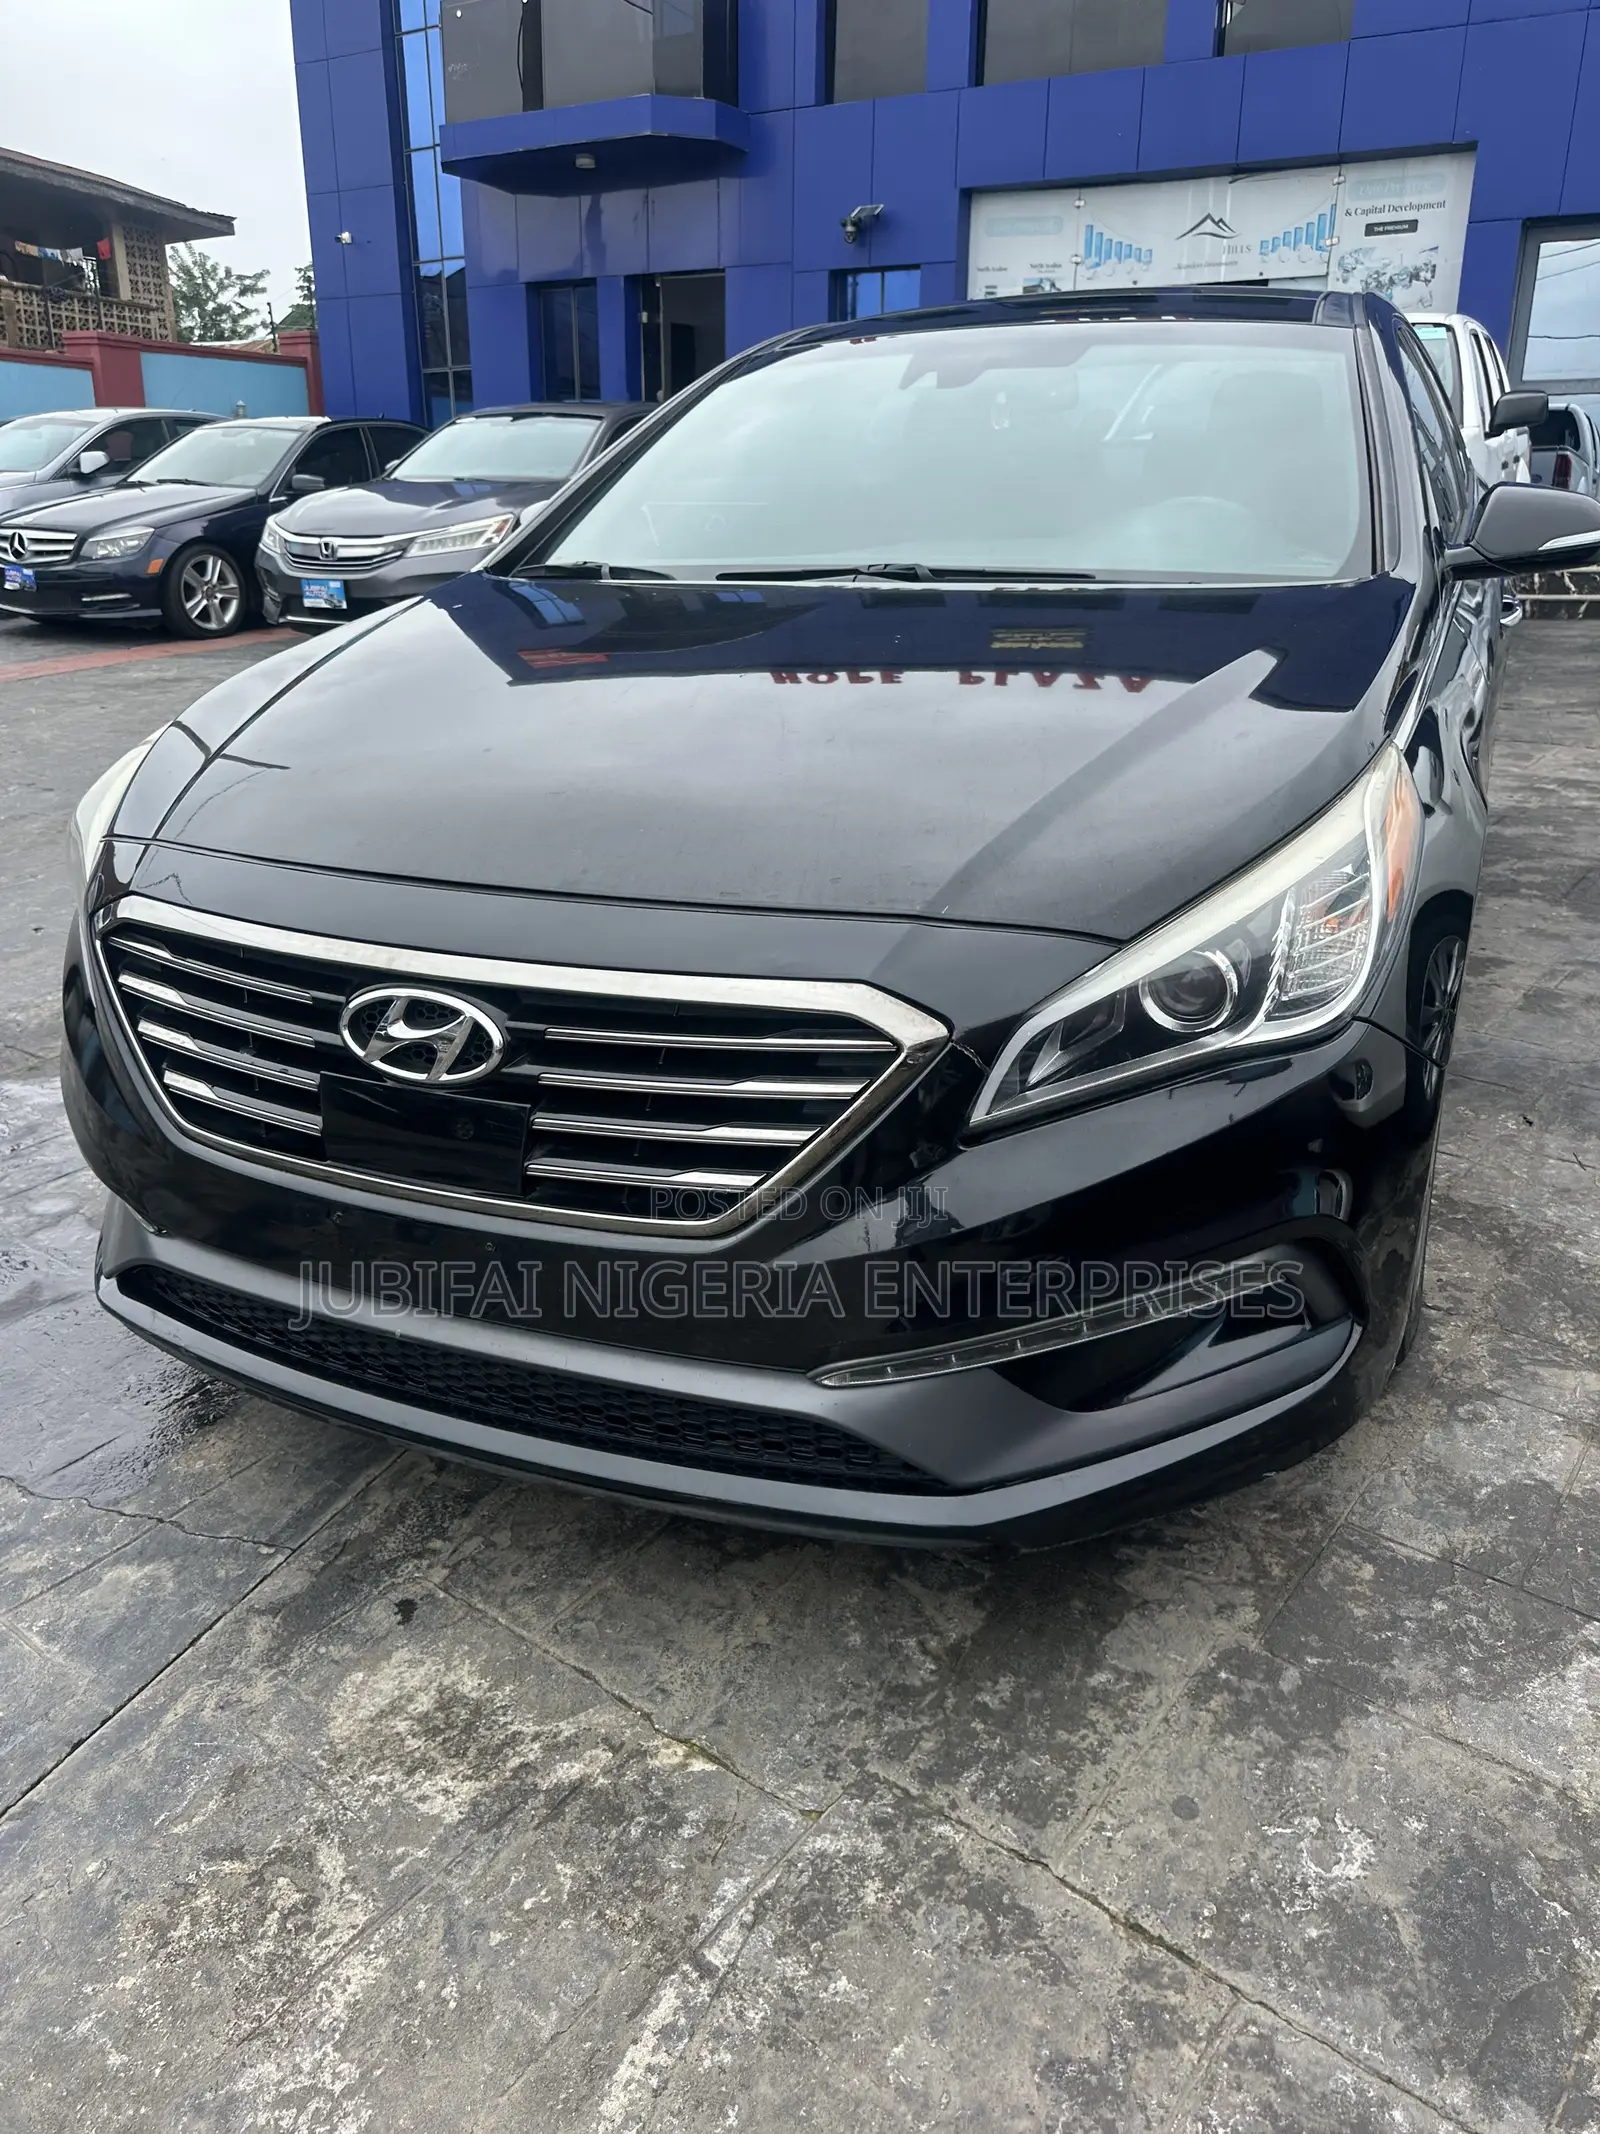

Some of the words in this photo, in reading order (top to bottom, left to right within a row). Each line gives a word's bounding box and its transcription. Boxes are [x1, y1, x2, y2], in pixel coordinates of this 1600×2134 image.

[1344, 208, 1353, 217] &
[1354, 204, 1386, 217] Capital
[1387, 200, 1446, 213] Development
[1385, 224, 1409, 232] PREMIUM
